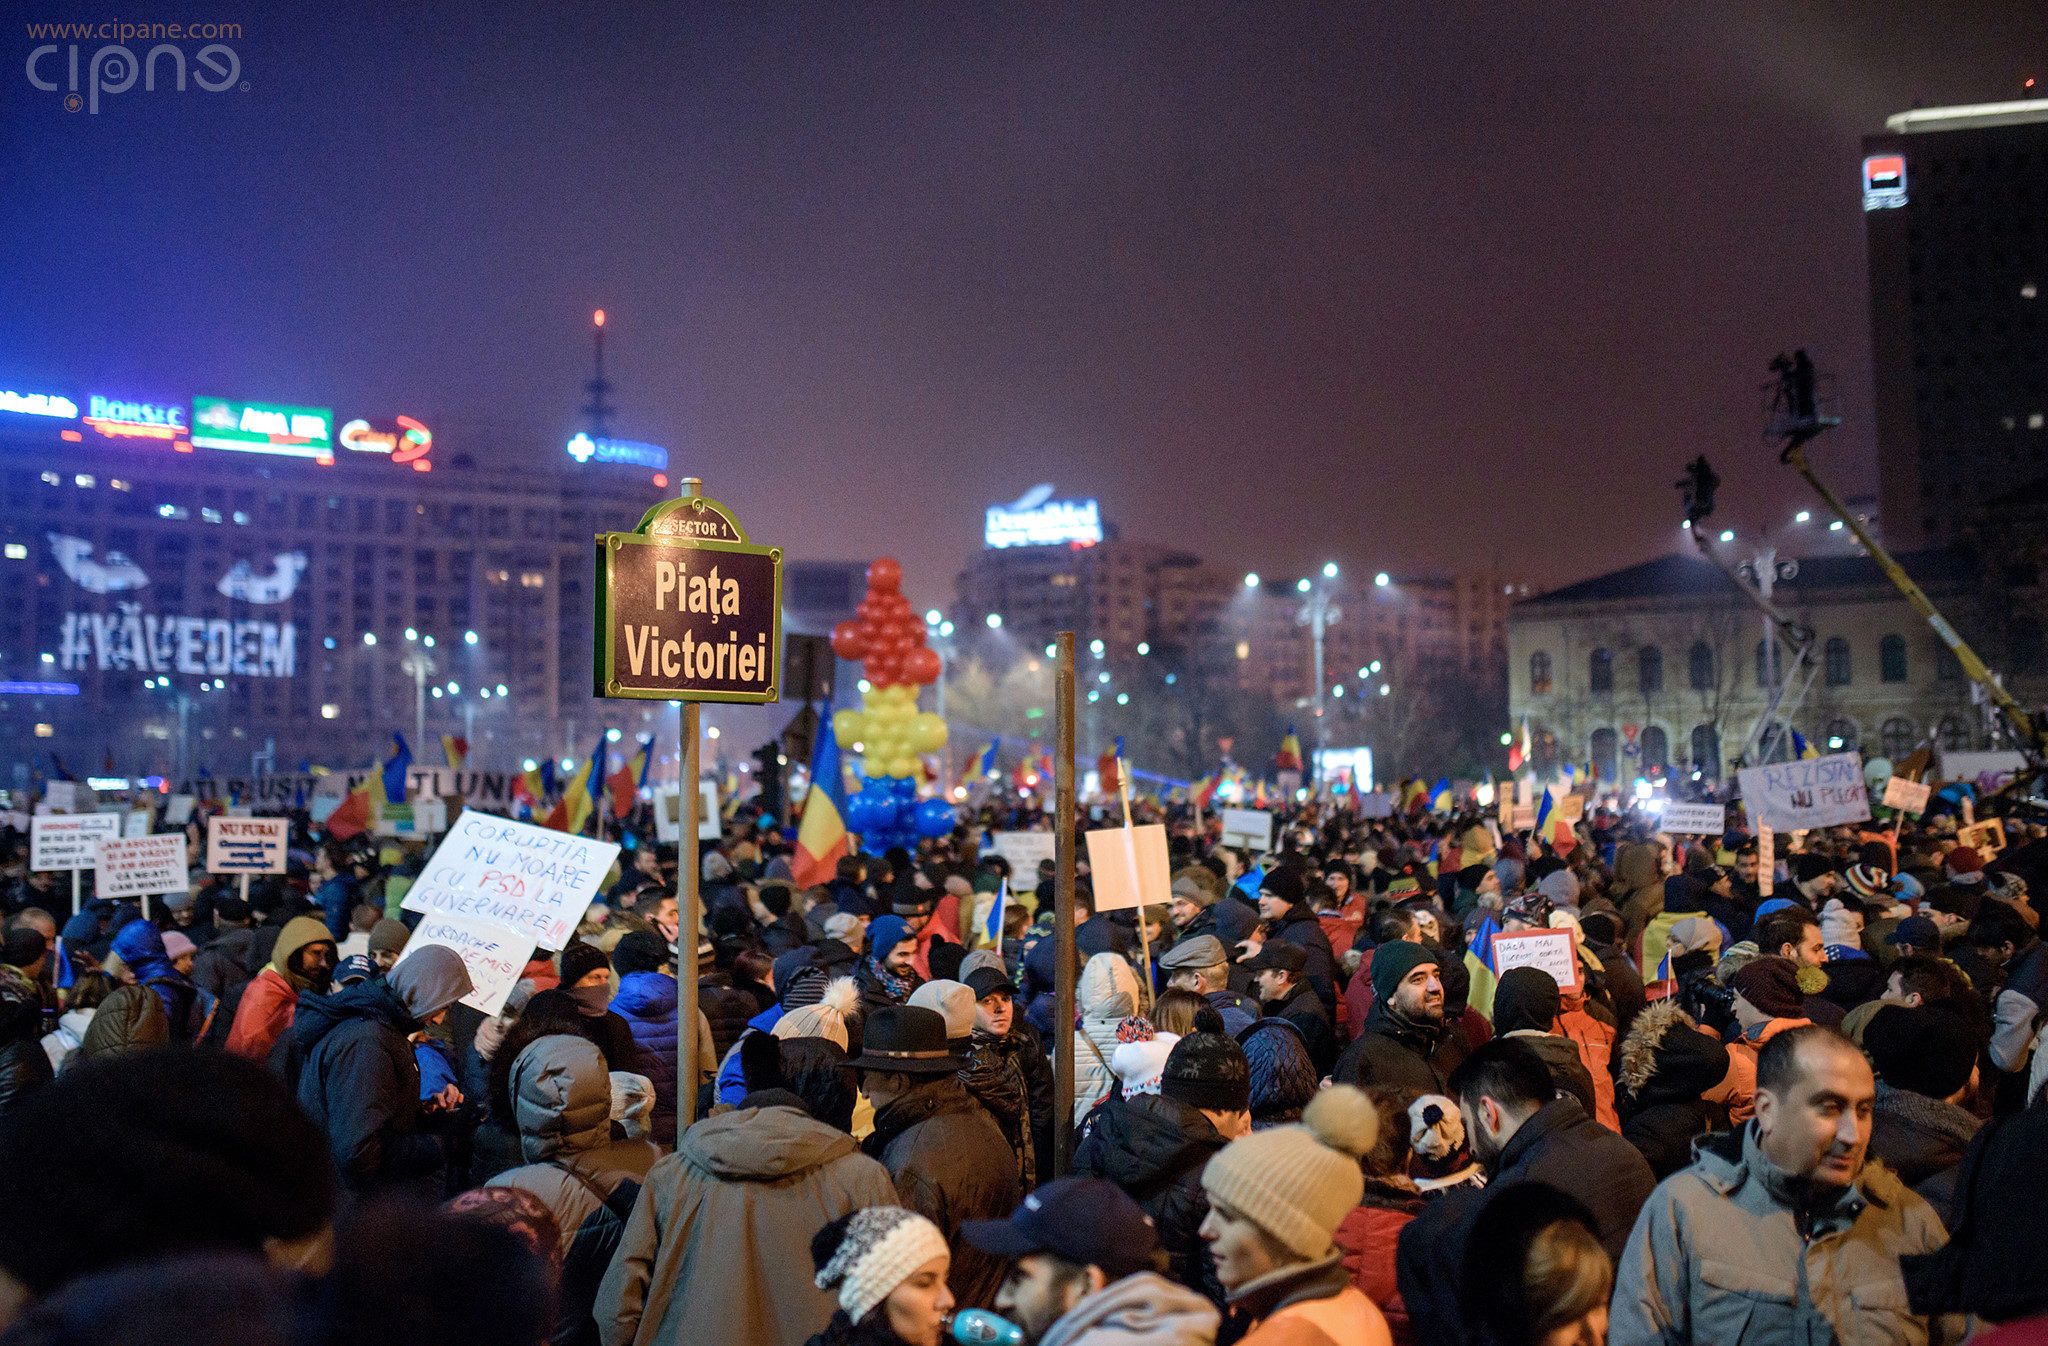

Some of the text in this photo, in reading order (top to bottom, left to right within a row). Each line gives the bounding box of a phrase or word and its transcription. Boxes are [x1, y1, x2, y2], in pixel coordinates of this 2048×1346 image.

[672, 519, 728, 537] SECTOR 1
[624, 624, 766, 682] Victoriei
[433, 866, 564, 909] CU PSD LA
[464, 845, 591, 891] NU MOARE
